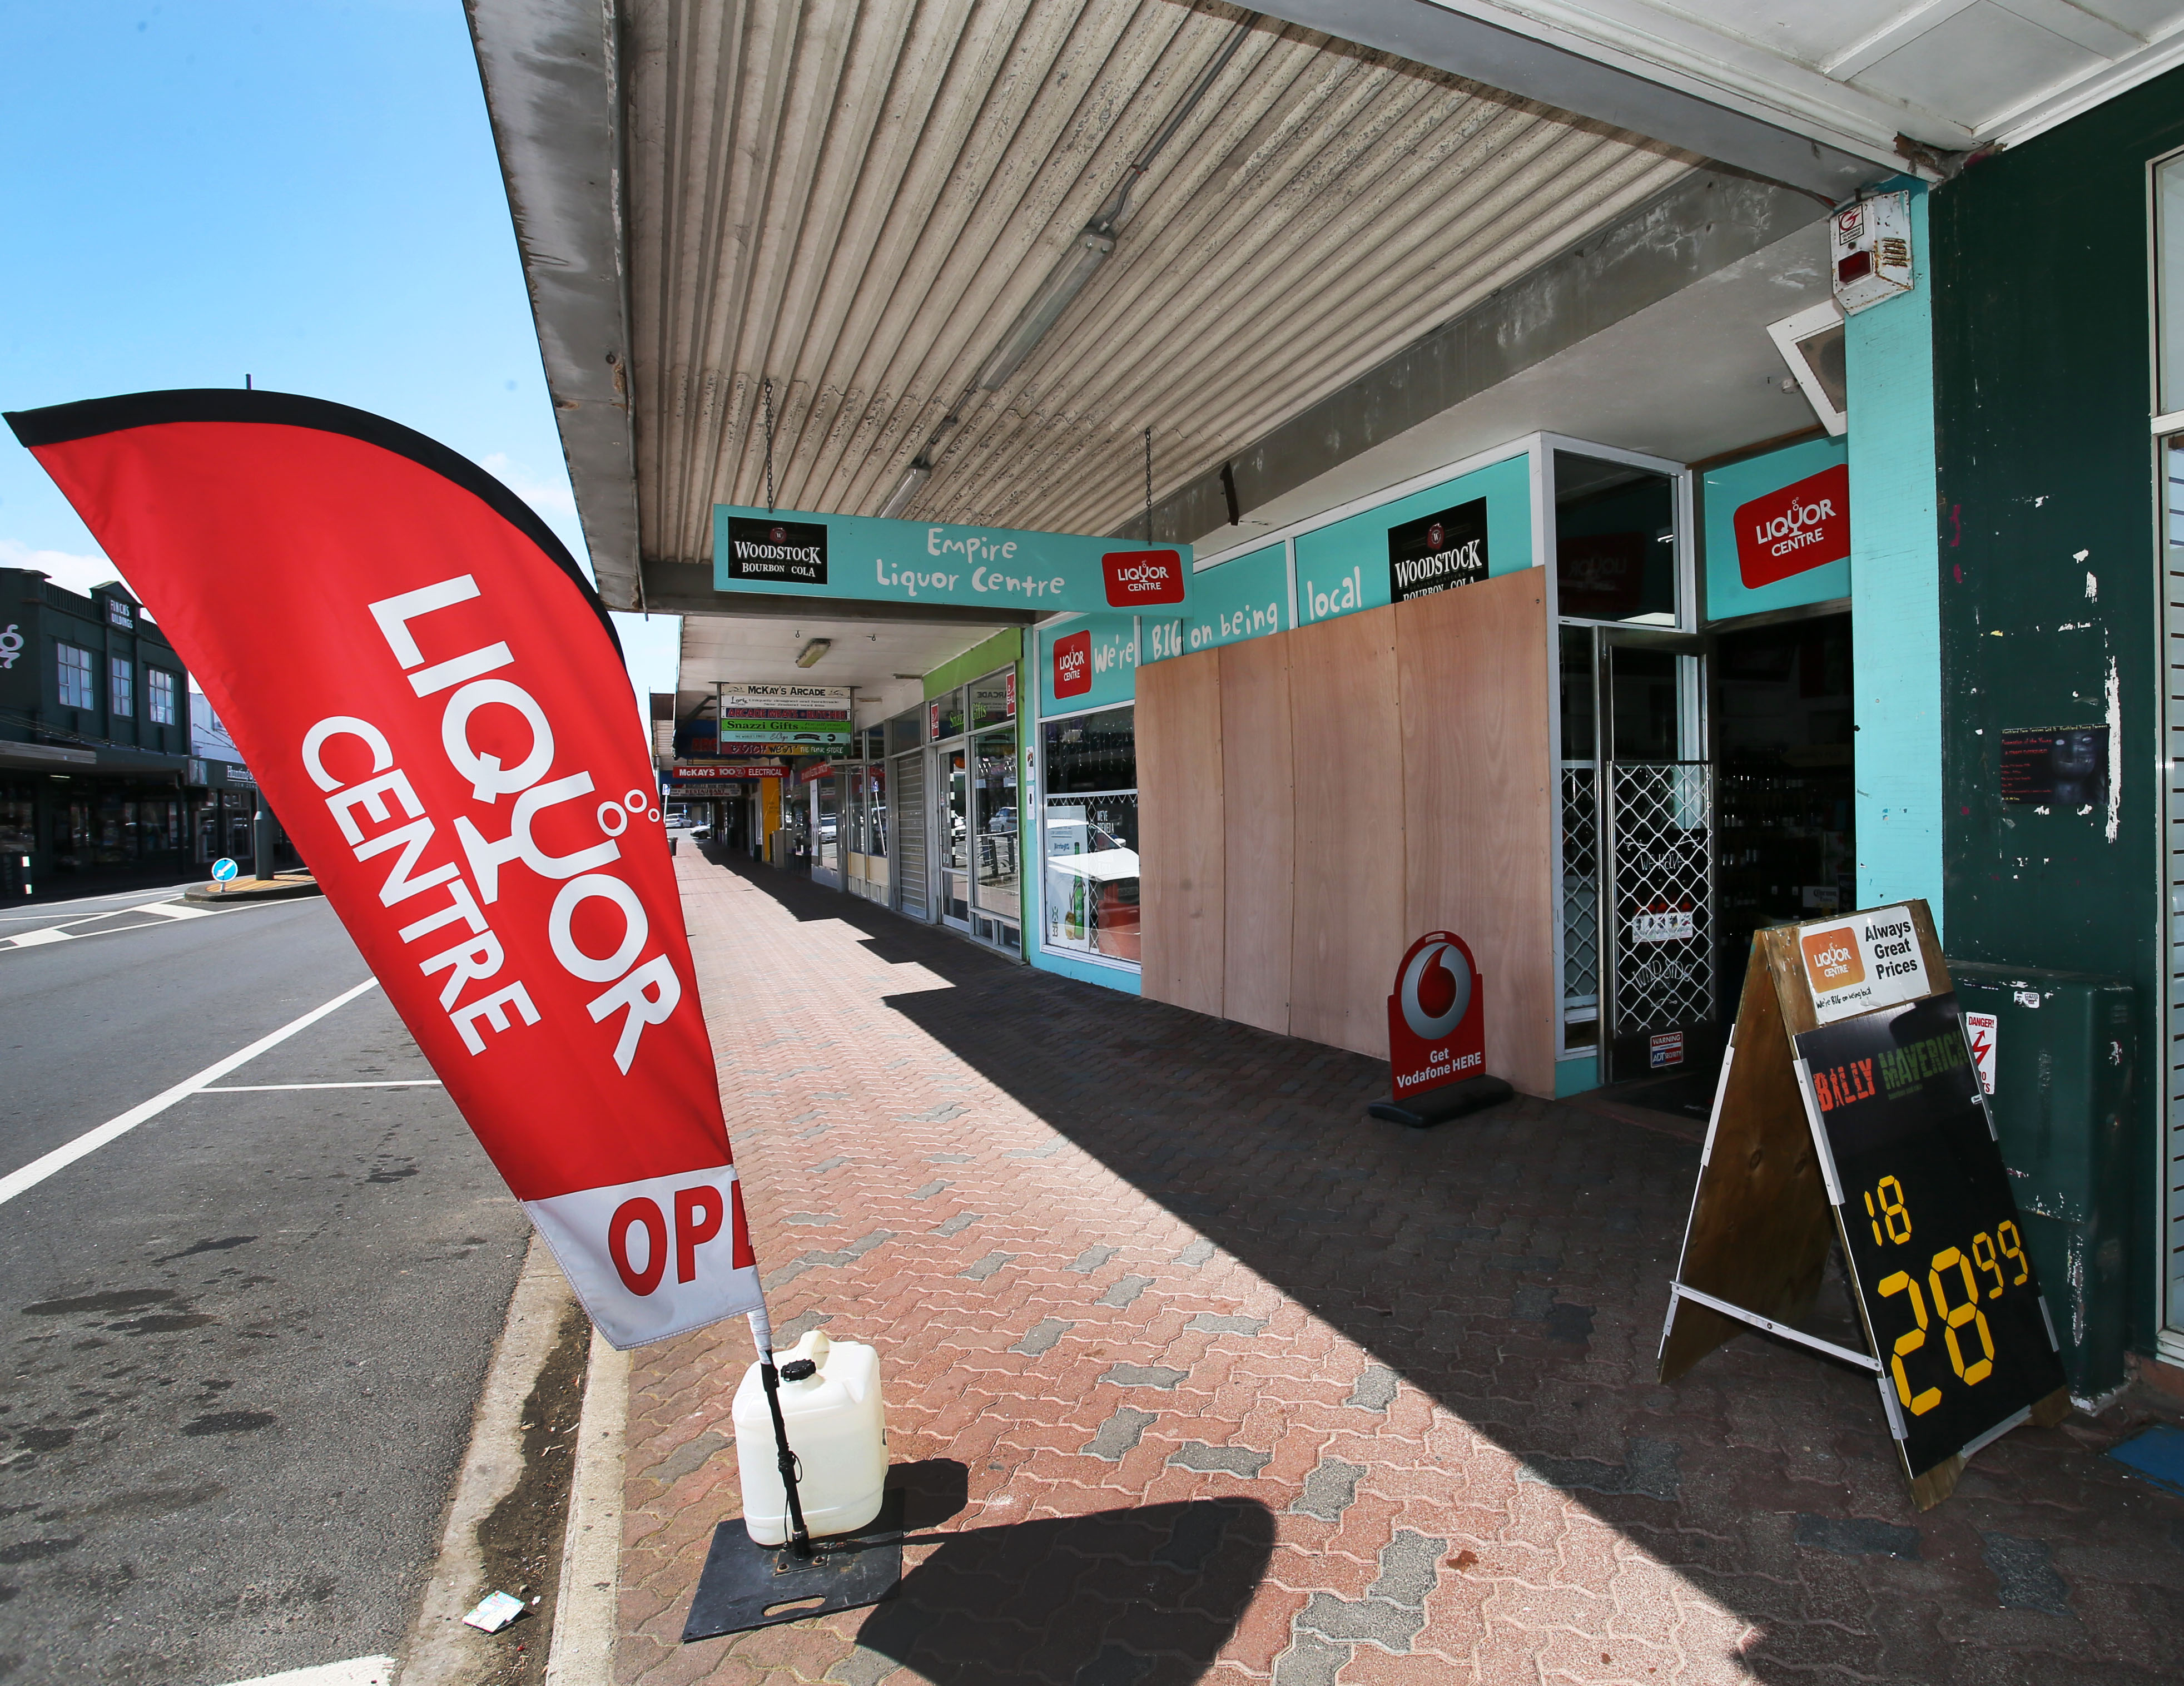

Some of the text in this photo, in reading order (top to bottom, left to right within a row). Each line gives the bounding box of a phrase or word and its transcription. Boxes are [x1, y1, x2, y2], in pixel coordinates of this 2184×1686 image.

[1842, 227, 1861, 239] GUARDIAN
[1843, 231, 1860, 242] ALARMED
[1755, 499, 1836, 545] LIQUOR
[734, 541, 821, 564] WOODSTOCK
[927, 528, 1017, 564] Empire
[1771, 528, 1824, 557] CENTRE
[742, 563, 816, 577] BOURBON COLA
[1394, 539, 1482, 588] WOODSTOCK
[876, 559, 1065, 597] Liquor Centre
[1118, 566, 1169, 583] LIQUOR
[1128, 582, 1162, 592] CENTRE
[111, 613, 133, 629] UILDINGS
[1094, 566, 1362, 674] We're BIG on being local
[1059, 651, 1084, 671] LIQUOR
[1064, 670, 1080, 681] CENTRE
[790, 687, 825, 696] ARCADE
[728, 708, 846, 720] ARCADE MEATS BUTCHER
[971, 702, 987, 721] Gifts
[727, 720, 798, 730] Snazzi Gifts
[368, 573, 681, 1076] LIQUOR
[301, 716, 542, 1057] CENTRE
[1865, 921, 1911, 942] Always
[1814, 948, 1852, 968] LIQUOR
[1874, 938, 1911, 959] Great
[1824, 964, 1848, 978] CENTRE
[1875, 959, 1918, 980] Prices
[1816, 998, 1830, 1009] We're
[1831, 995, 1841, 1005] BIG
[1861, 986, 1872, 995] local
[1969, 1016, 1994, 1028] DANGER!
[1652, 1035, 1680, 1045] WARNING
[1430, 1048, 1449, 1063] Get
[1652, 1052, 1665, 1063] ADT
[1397, 1052, 1481, 1088] Vodafone HERE
[1813, 1030, 1970, 1112] BILLY MAVERICK
[1864, 1175, 1912, 1246] 18
[1878, 1220, 2028, 1416] 28 99
